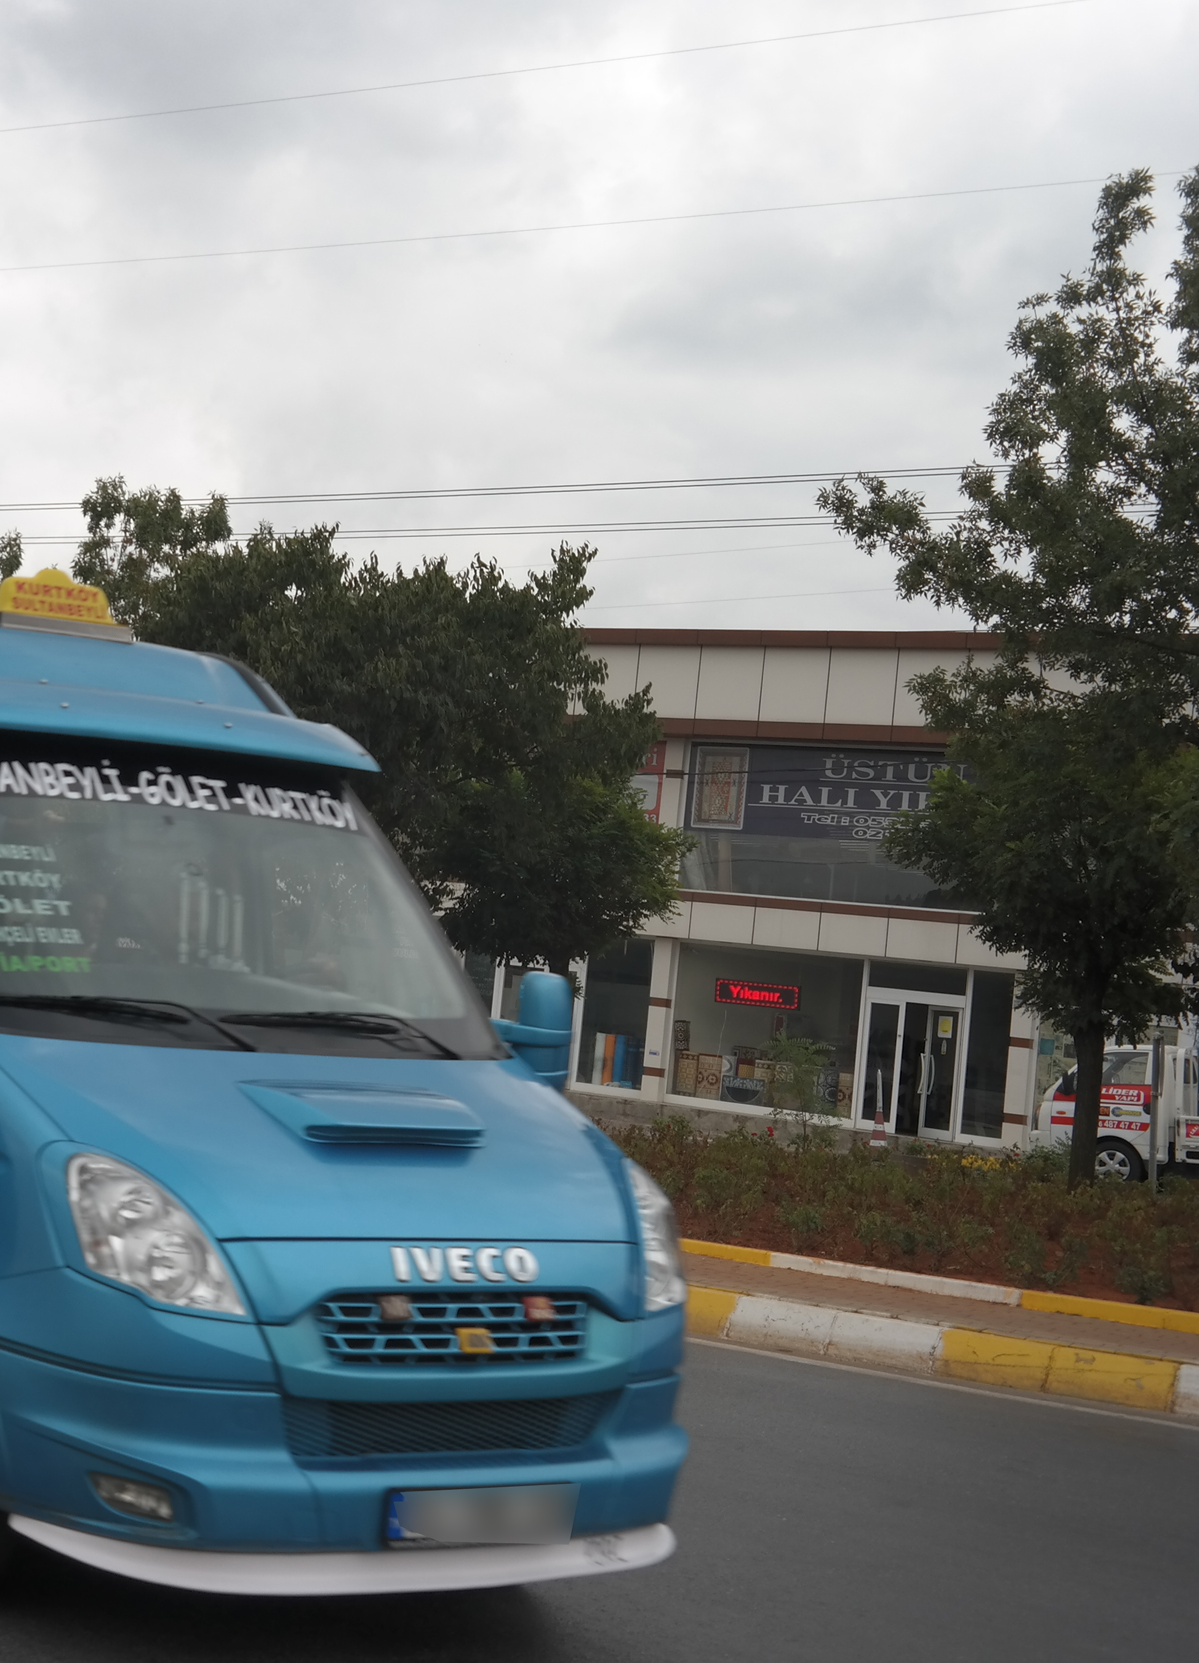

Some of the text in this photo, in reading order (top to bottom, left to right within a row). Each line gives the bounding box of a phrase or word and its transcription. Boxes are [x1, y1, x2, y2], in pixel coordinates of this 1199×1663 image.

[758, 783, 859, 809] HALI
[1104, 1120, 1118, 1128] 487
[1120, 1121, 1129, 1129] 47
[1131, 1122, 1141, 1130] 47
[390, 1245, 541, 1284] IVECO
